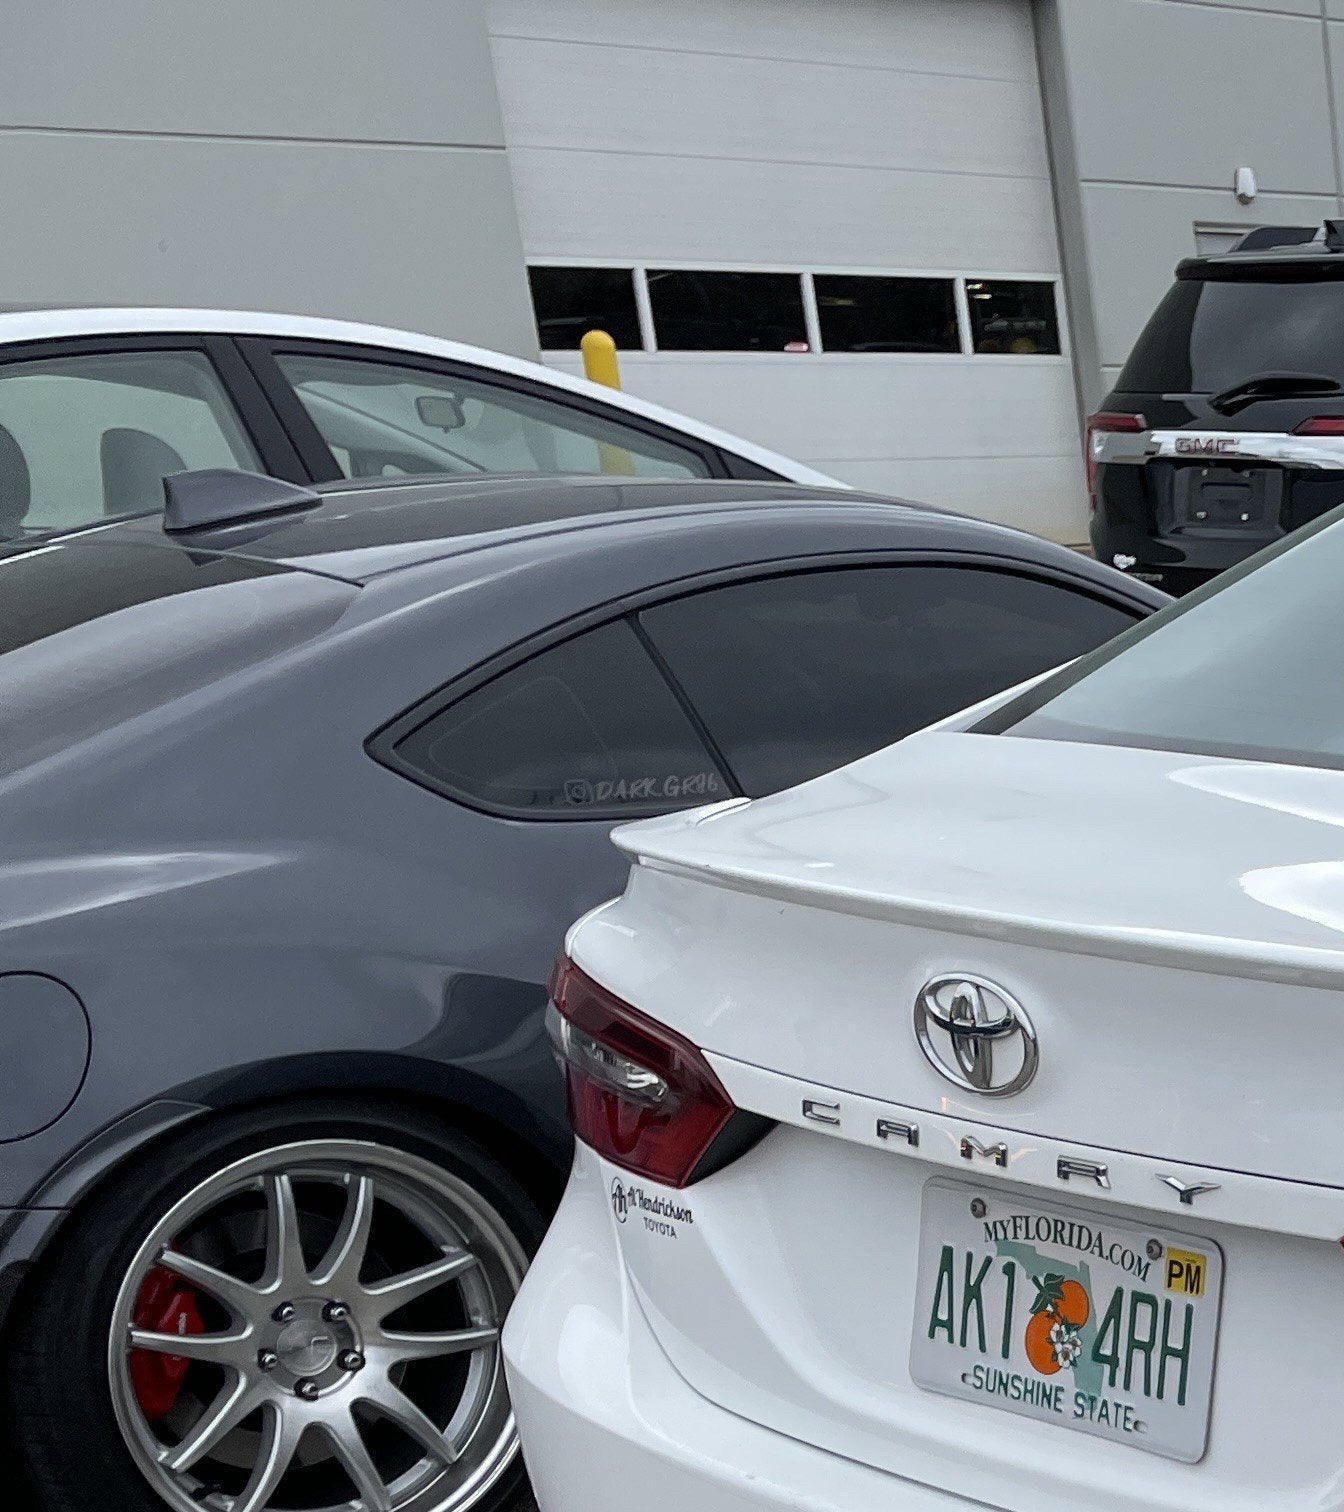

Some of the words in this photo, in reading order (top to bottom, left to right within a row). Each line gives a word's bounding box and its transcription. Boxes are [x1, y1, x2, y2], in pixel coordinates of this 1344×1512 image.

[1174, 437, 1240, 454] GMC
[801, 1098, 1222, 1205] CAMRY
[643, 1216, 677, 1239] TOYOTA
[983, 1215, 1152, 1283] MYFLORIDA.COM
[1167, 1259, 1201, 1295] PM
[972, 1364, 1066, 1413] SUNSHINE
[1073, 1391, 1135, 1433] STATE
